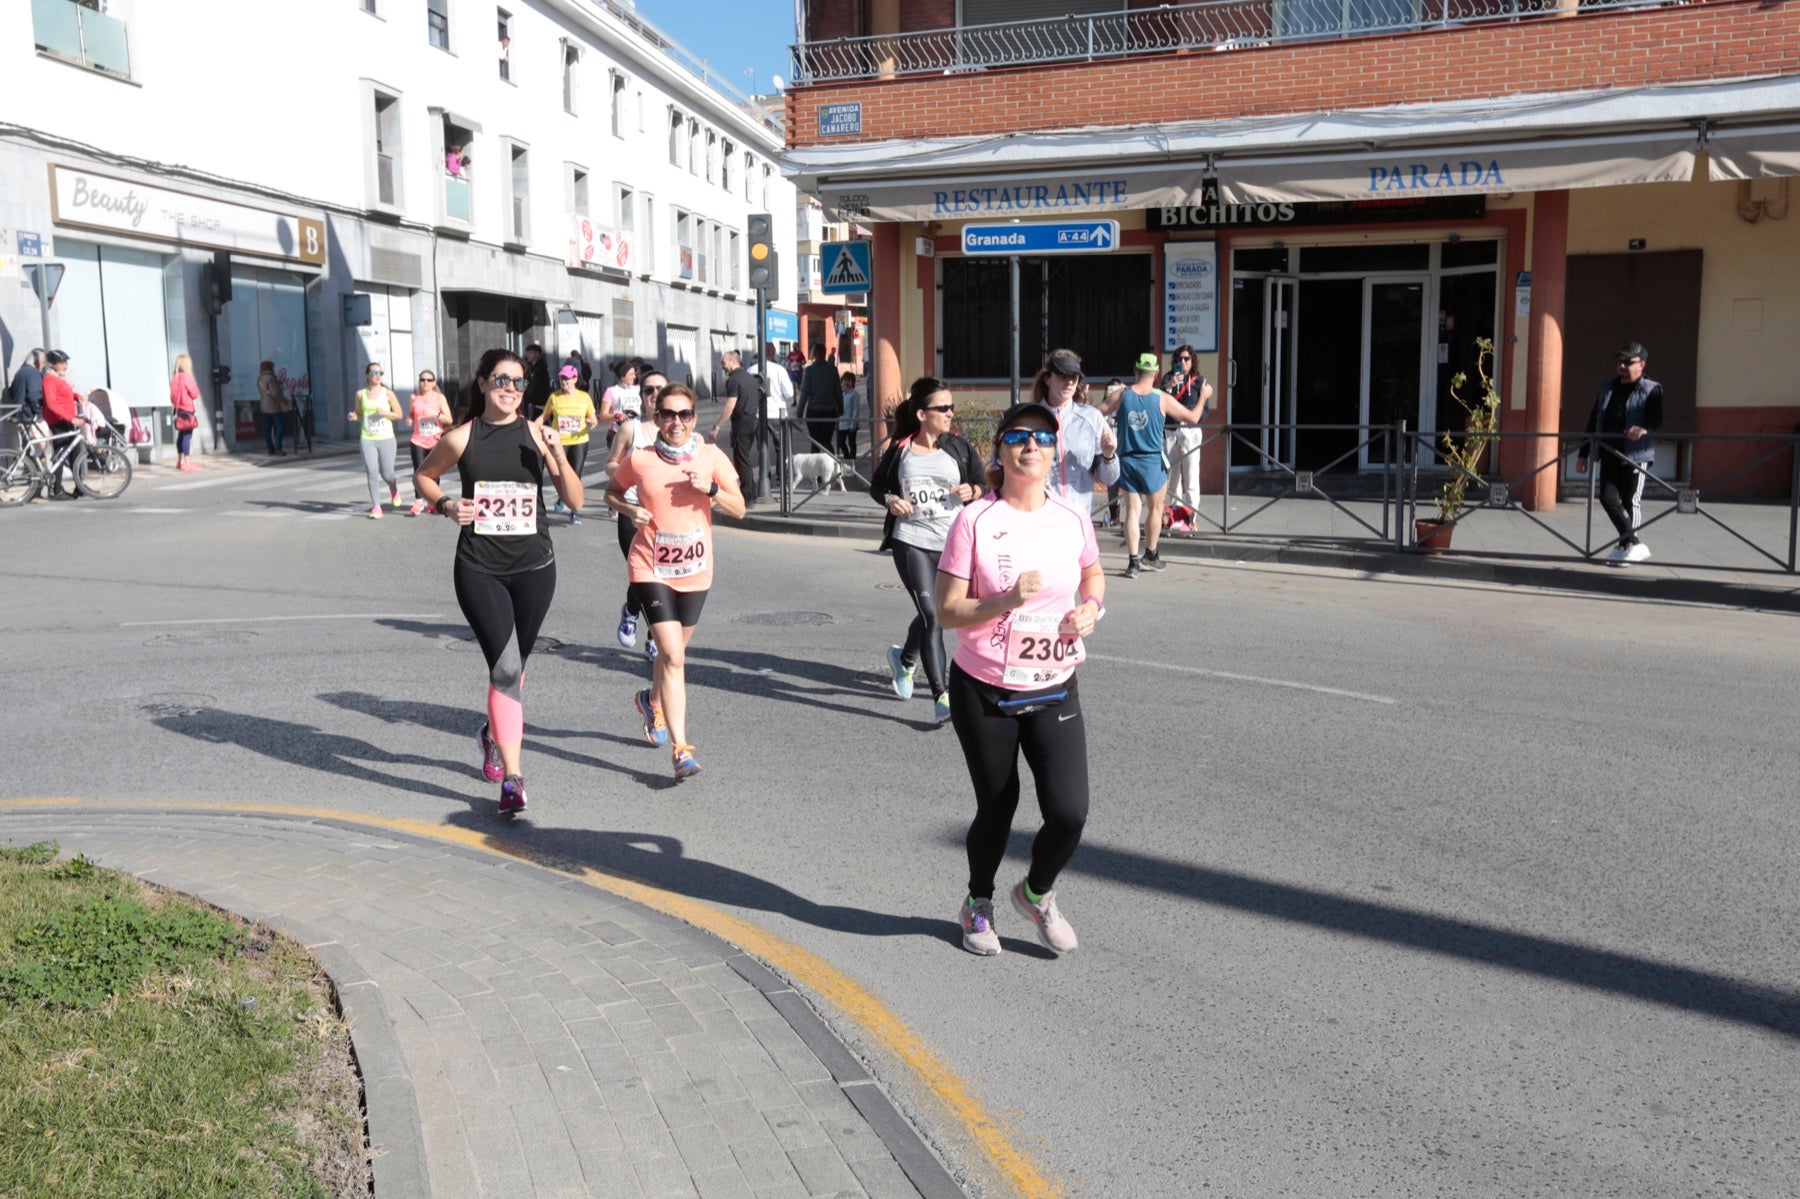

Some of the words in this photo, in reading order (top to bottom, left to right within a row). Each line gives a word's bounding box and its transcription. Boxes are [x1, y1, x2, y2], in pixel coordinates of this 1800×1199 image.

[829, 105, 859, 114] AVENIDA
[831, 113, 857, 123] JACOBO
[821, 122, 859, 134] CAMARERO
[1368, 159, 1505, 191] PARADA
[72, 177, 148, 227] Beauty
[933, 180, 1128, 214] RESTAURANTE
[161, 209, 185, 225] THE
[190, 215, 221, 230] SHOP
[1160, 202, 1296, 226] BICHITOS
[306, 226, 319, 255] B
[966, 233, 1026, 246] Granada
[1060, 232, 1087, 242] A-44
[478, 498, 534, 517] 2215
[909, 488, 946, 506] 3042
[658, 541, 704, 563] 2240
[1018, 637, 1078, 662] 2304
